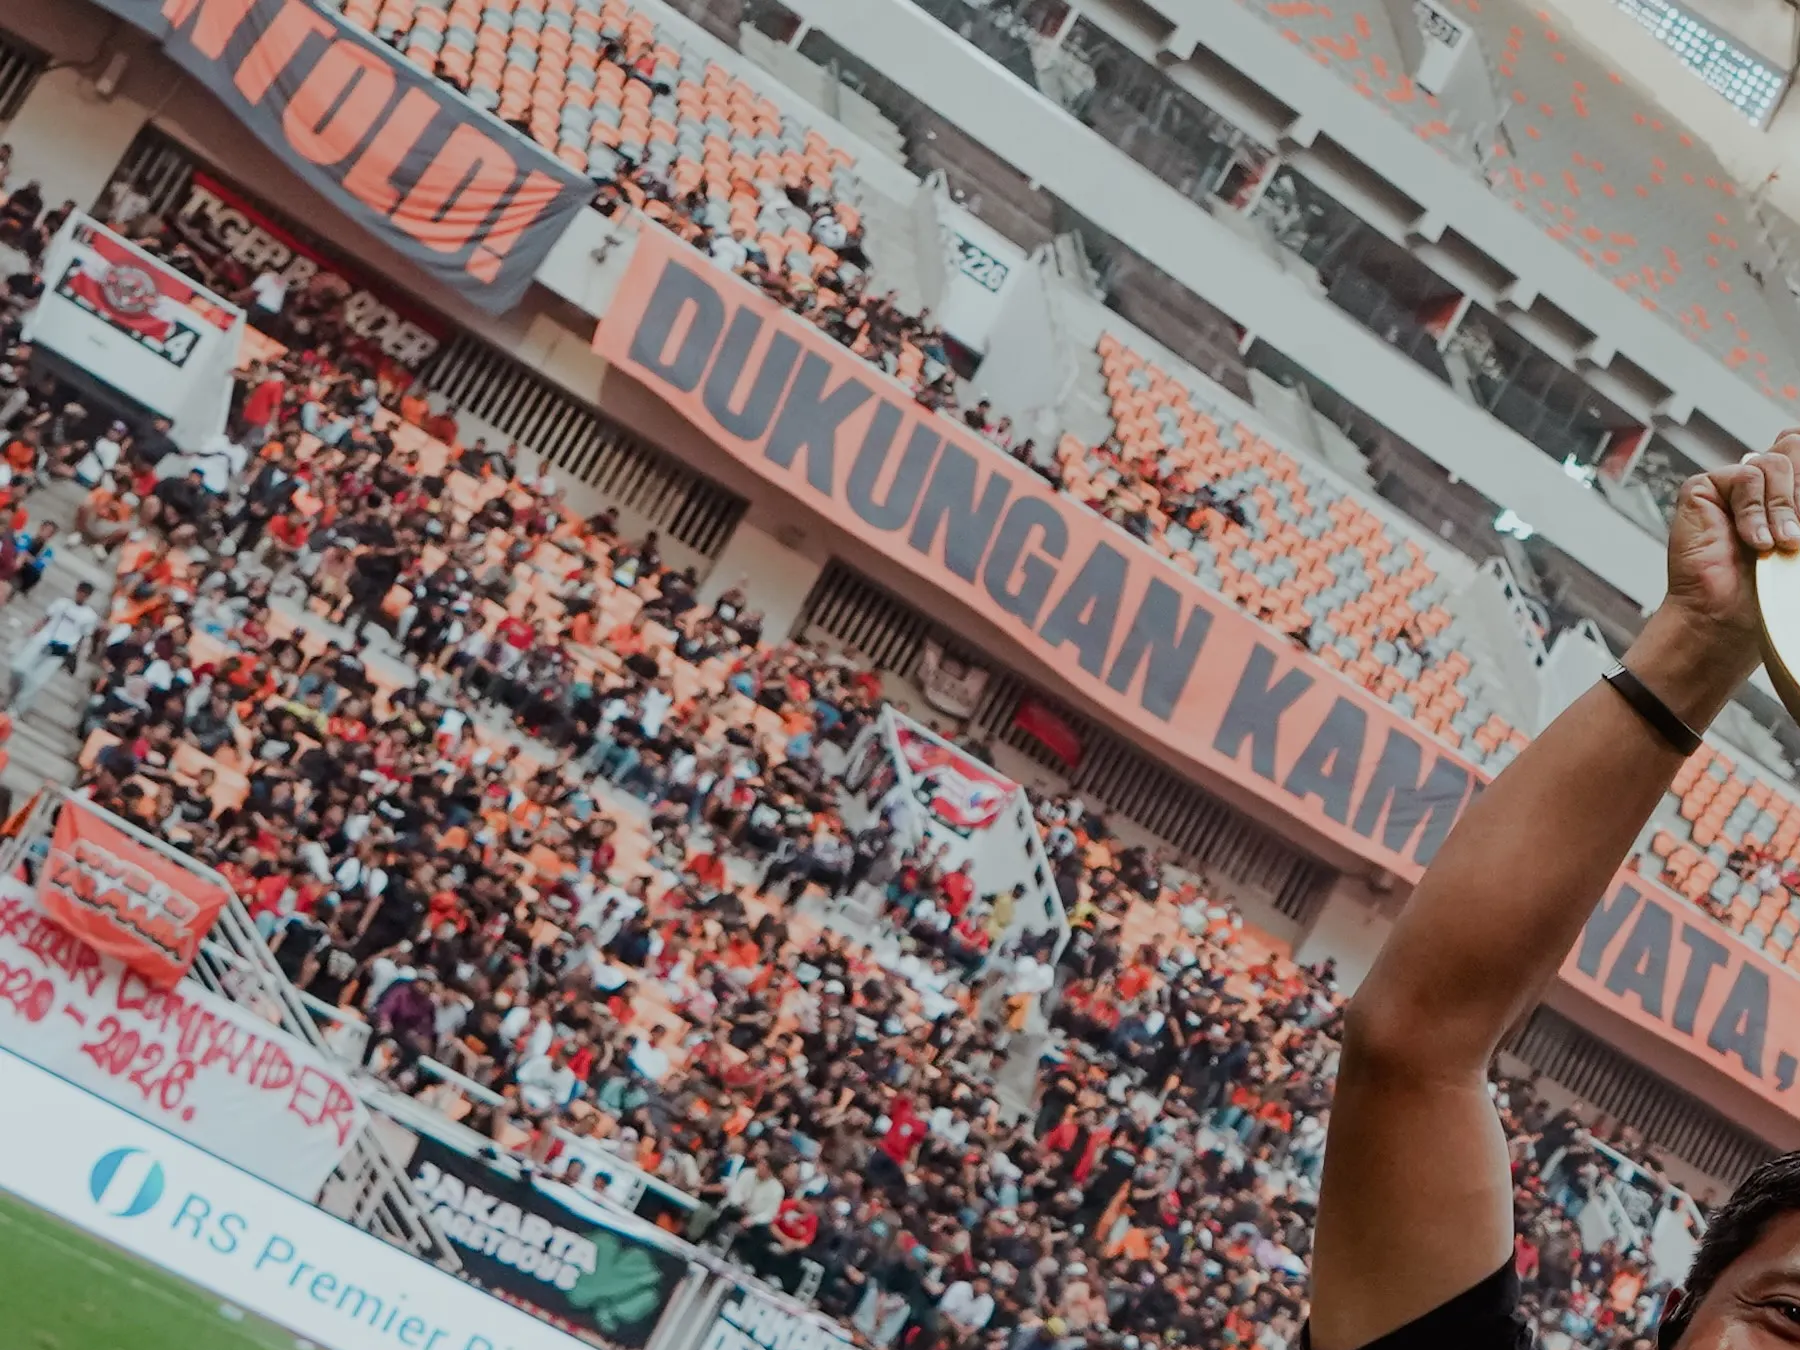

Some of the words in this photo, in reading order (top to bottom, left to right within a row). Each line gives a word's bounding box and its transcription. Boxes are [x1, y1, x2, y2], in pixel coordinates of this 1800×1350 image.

[629, 258, 1213, 722] DUKUNGAN
[1212, 635, 1488, 869] KAM
[1574, 880, 1800, 1093] YATA,
[170, 1191, 250, 1256] RS
[412, 1160, 598, 1276] JAKARTA
